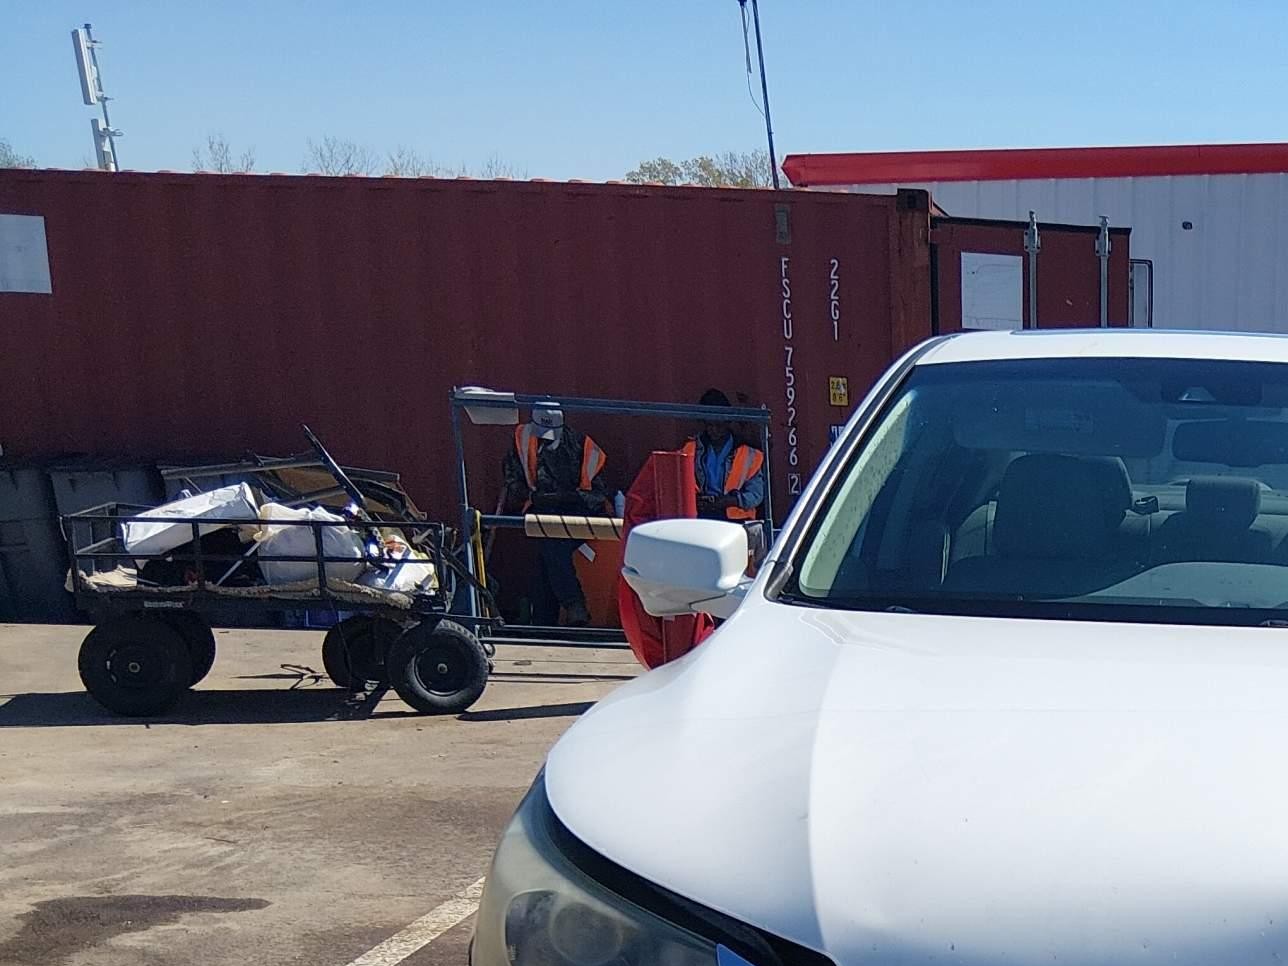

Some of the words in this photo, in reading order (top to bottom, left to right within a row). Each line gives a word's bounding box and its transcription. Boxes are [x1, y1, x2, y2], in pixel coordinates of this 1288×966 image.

[781, 257, 792, 340] FSCU
[790, 475, 799, 494] 2
[830, 258, 840, 341] 22G1
